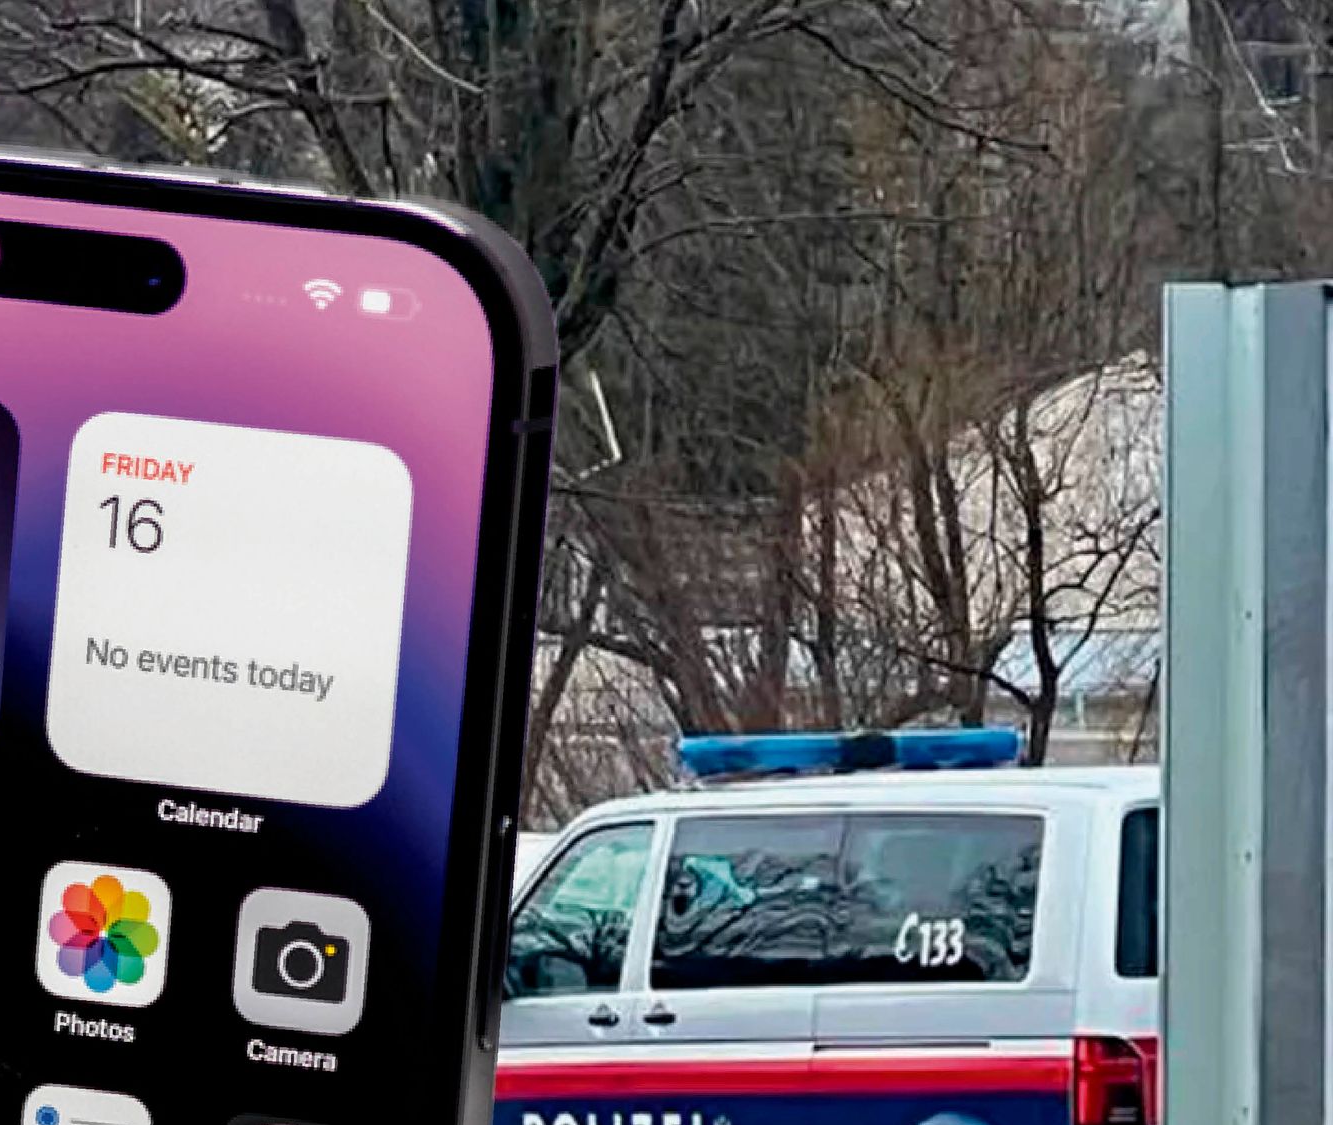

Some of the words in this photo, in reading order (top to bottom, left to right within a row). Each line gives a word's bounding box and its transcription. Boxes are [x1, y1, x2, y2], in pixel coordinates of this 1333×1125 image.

[101, 452, 194, 484] FRIDAY
[99, 494, 165, 554] 16
[86, 637, 129, 670] No
[137, 647, 238, 684] events
[247, 656, 334, 701] today
[157, 799, 264, 833] Calendar
[919, 918, 965, 967] 133
[53, 1010, 136, 1043] Photos
[246, 1038, 338, 1072] Camera
